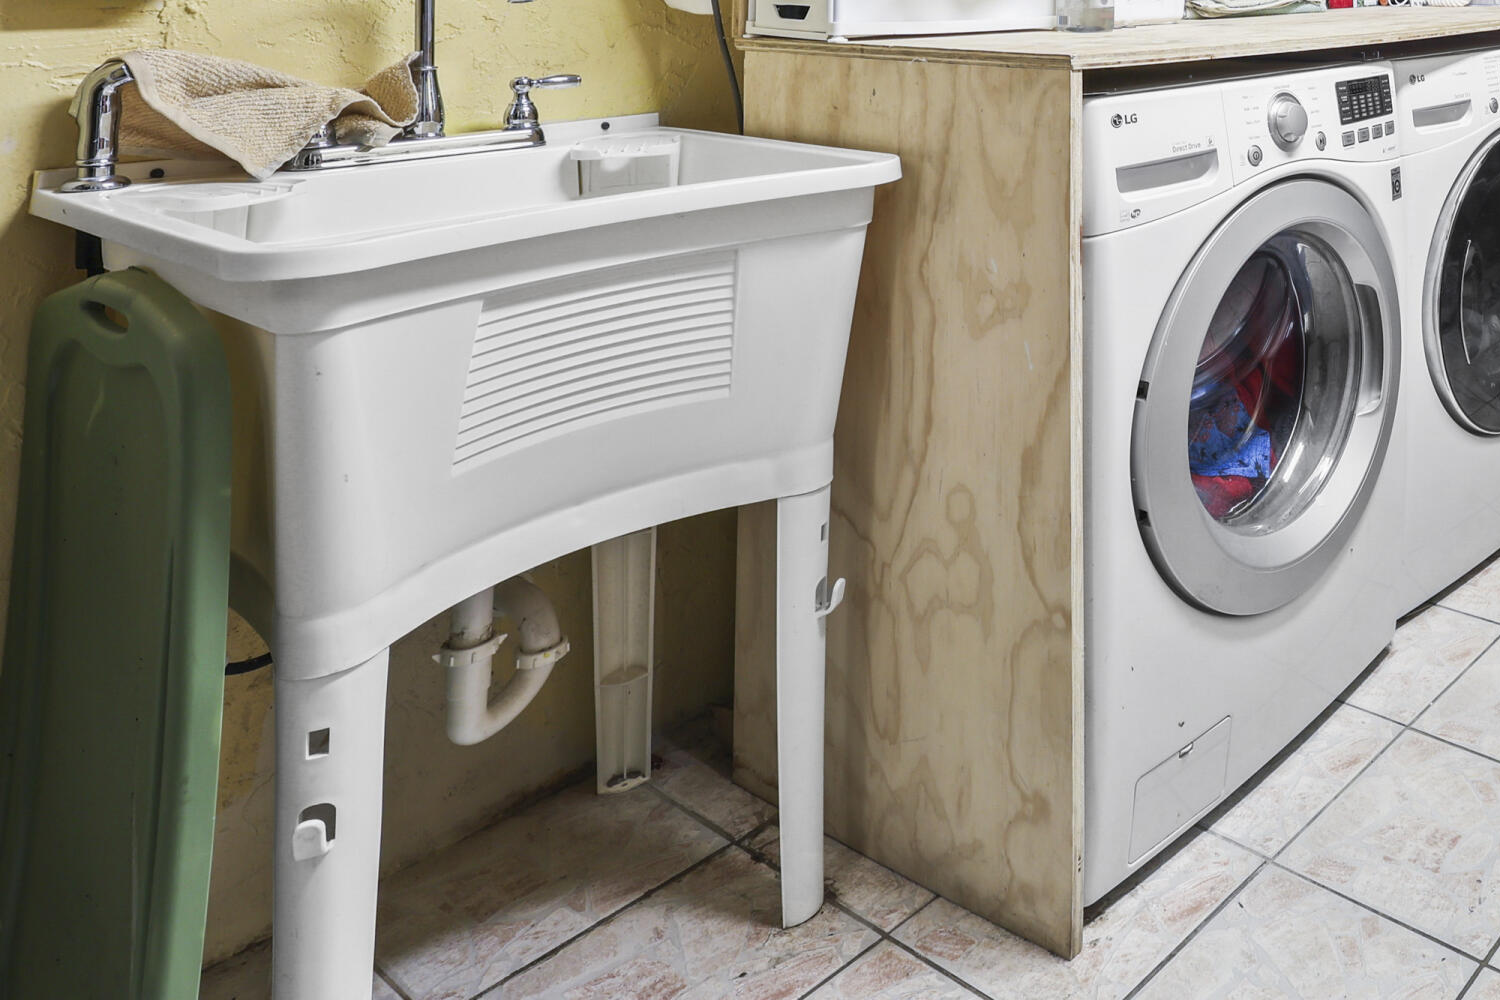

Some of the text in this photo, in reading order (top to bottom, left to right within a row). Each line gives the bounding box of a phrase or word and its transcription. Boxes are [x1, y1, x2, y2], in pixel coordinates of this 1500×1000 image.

[1124, 113, 1138, 125] LG
[1172, 142, 1201, 154] Direct Drive
